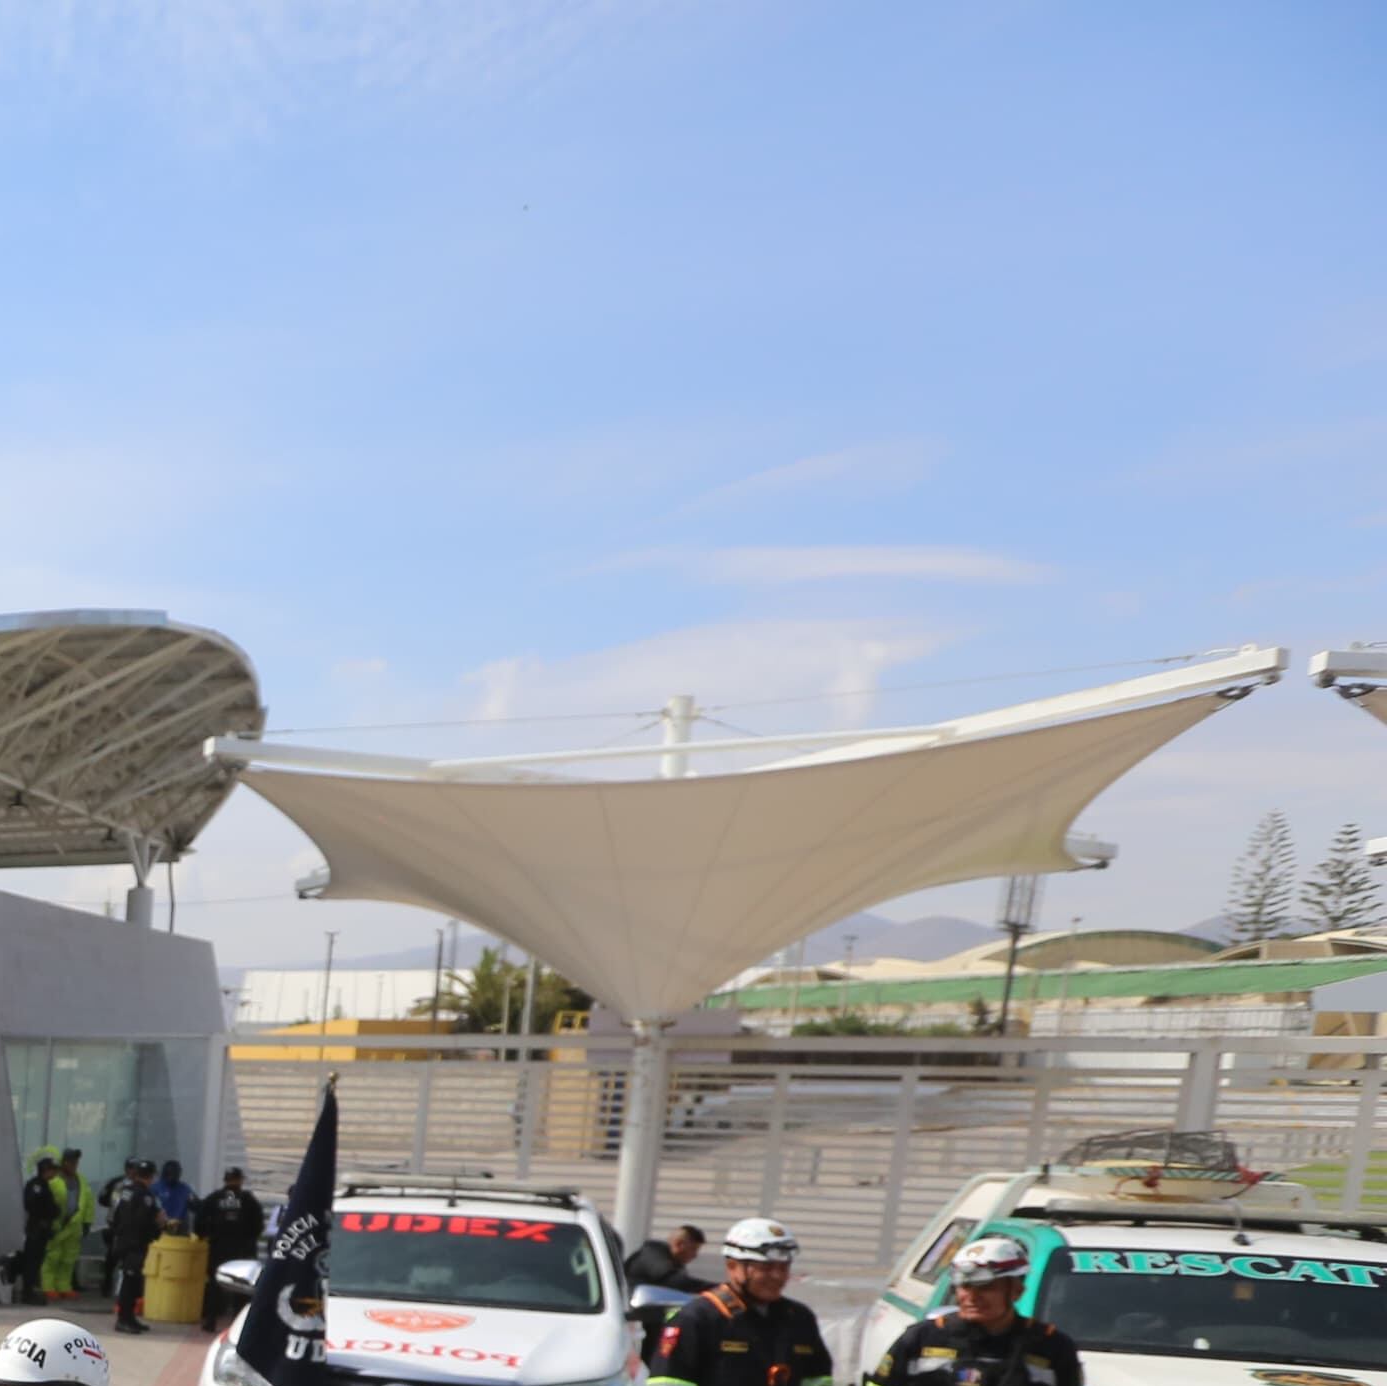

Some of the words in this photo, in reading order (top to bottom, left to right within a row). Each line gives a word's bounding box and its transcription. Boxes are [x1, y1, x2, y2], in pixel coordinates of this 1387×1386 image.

[272, 1213, 320, 1261] POLICIA
[342, 1213, 556, 1243] UDEX
[1070, 1251, 1387, 1287] RESCAT
